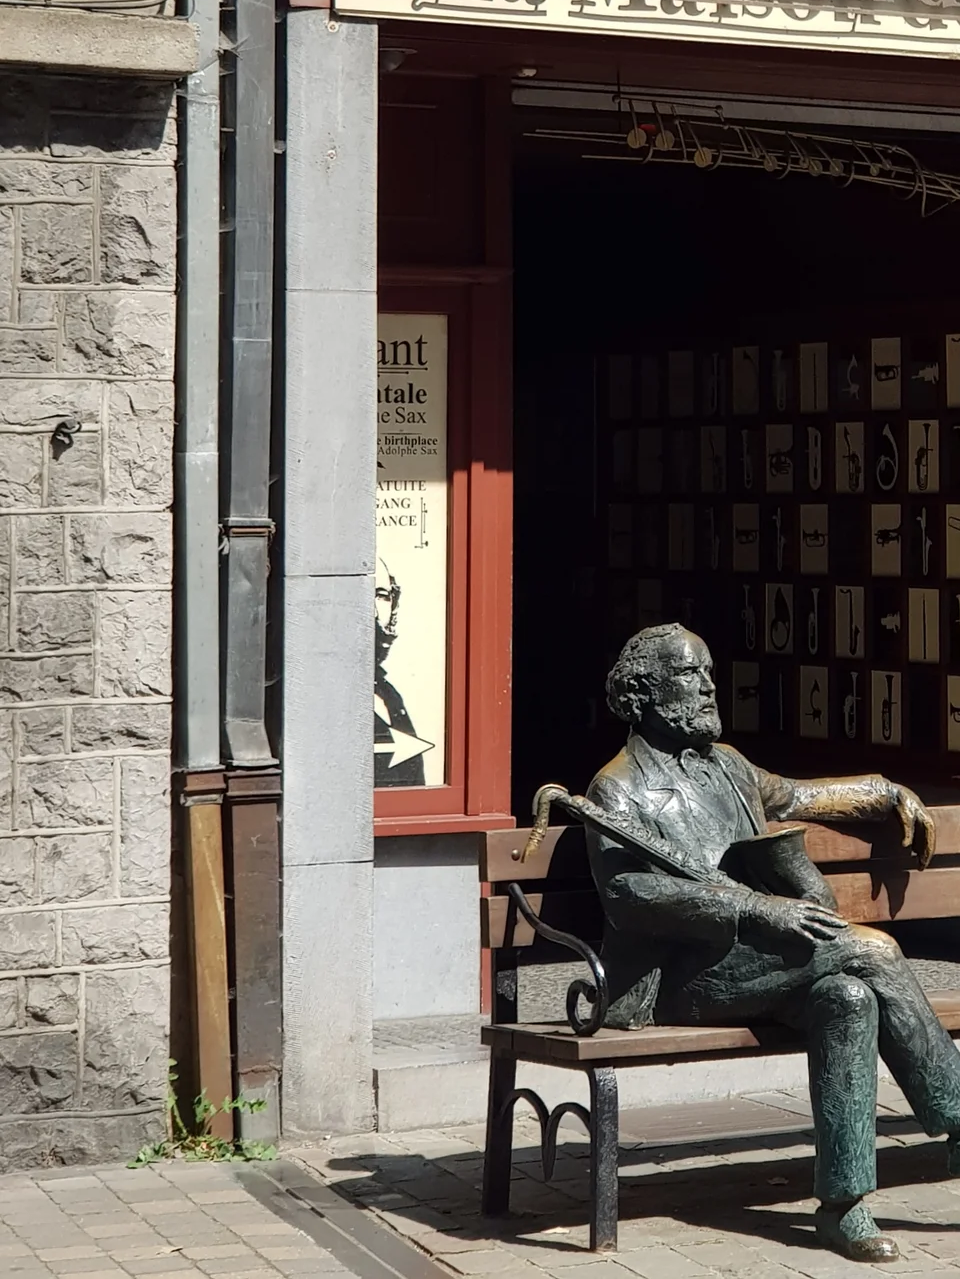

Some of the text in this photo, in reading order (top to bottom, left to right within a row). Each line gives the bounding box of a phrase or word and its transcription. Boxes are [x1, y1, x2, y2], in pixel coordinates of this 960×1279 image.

[395, 406, 427, 424] Sax
[384, 435, 438, 448] birthplace
[377, 446, 438, 458] Adolphe Sax
